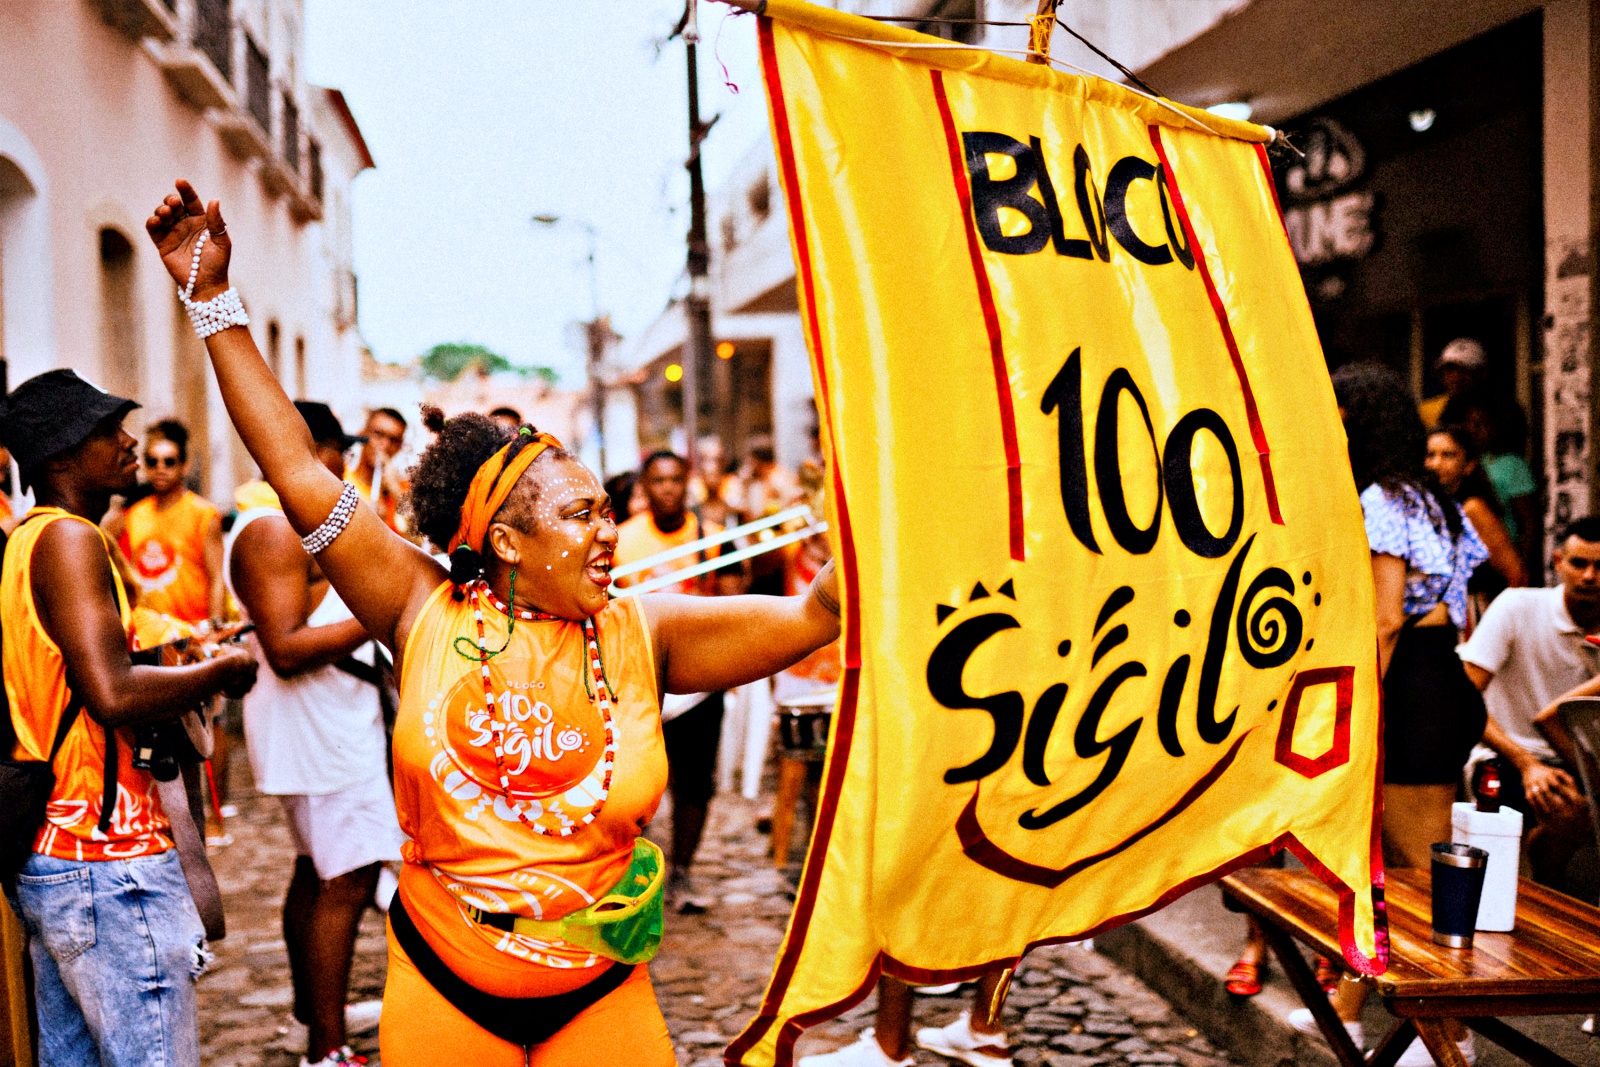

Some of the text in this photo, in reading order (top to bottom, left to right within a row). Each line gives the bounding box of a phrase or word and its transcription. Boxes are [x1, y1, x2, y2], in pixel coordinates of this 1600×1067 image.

[962, 131, 1195, 271] BLOCO
[1041, 346, 1244, 558] 100
[497, 690, 553, 724] 100
[507, 680, 545, 690] BLOCO
[927, 532, 1303, 830] Sigilo
[469, 714, 583, 776] Sigilo
